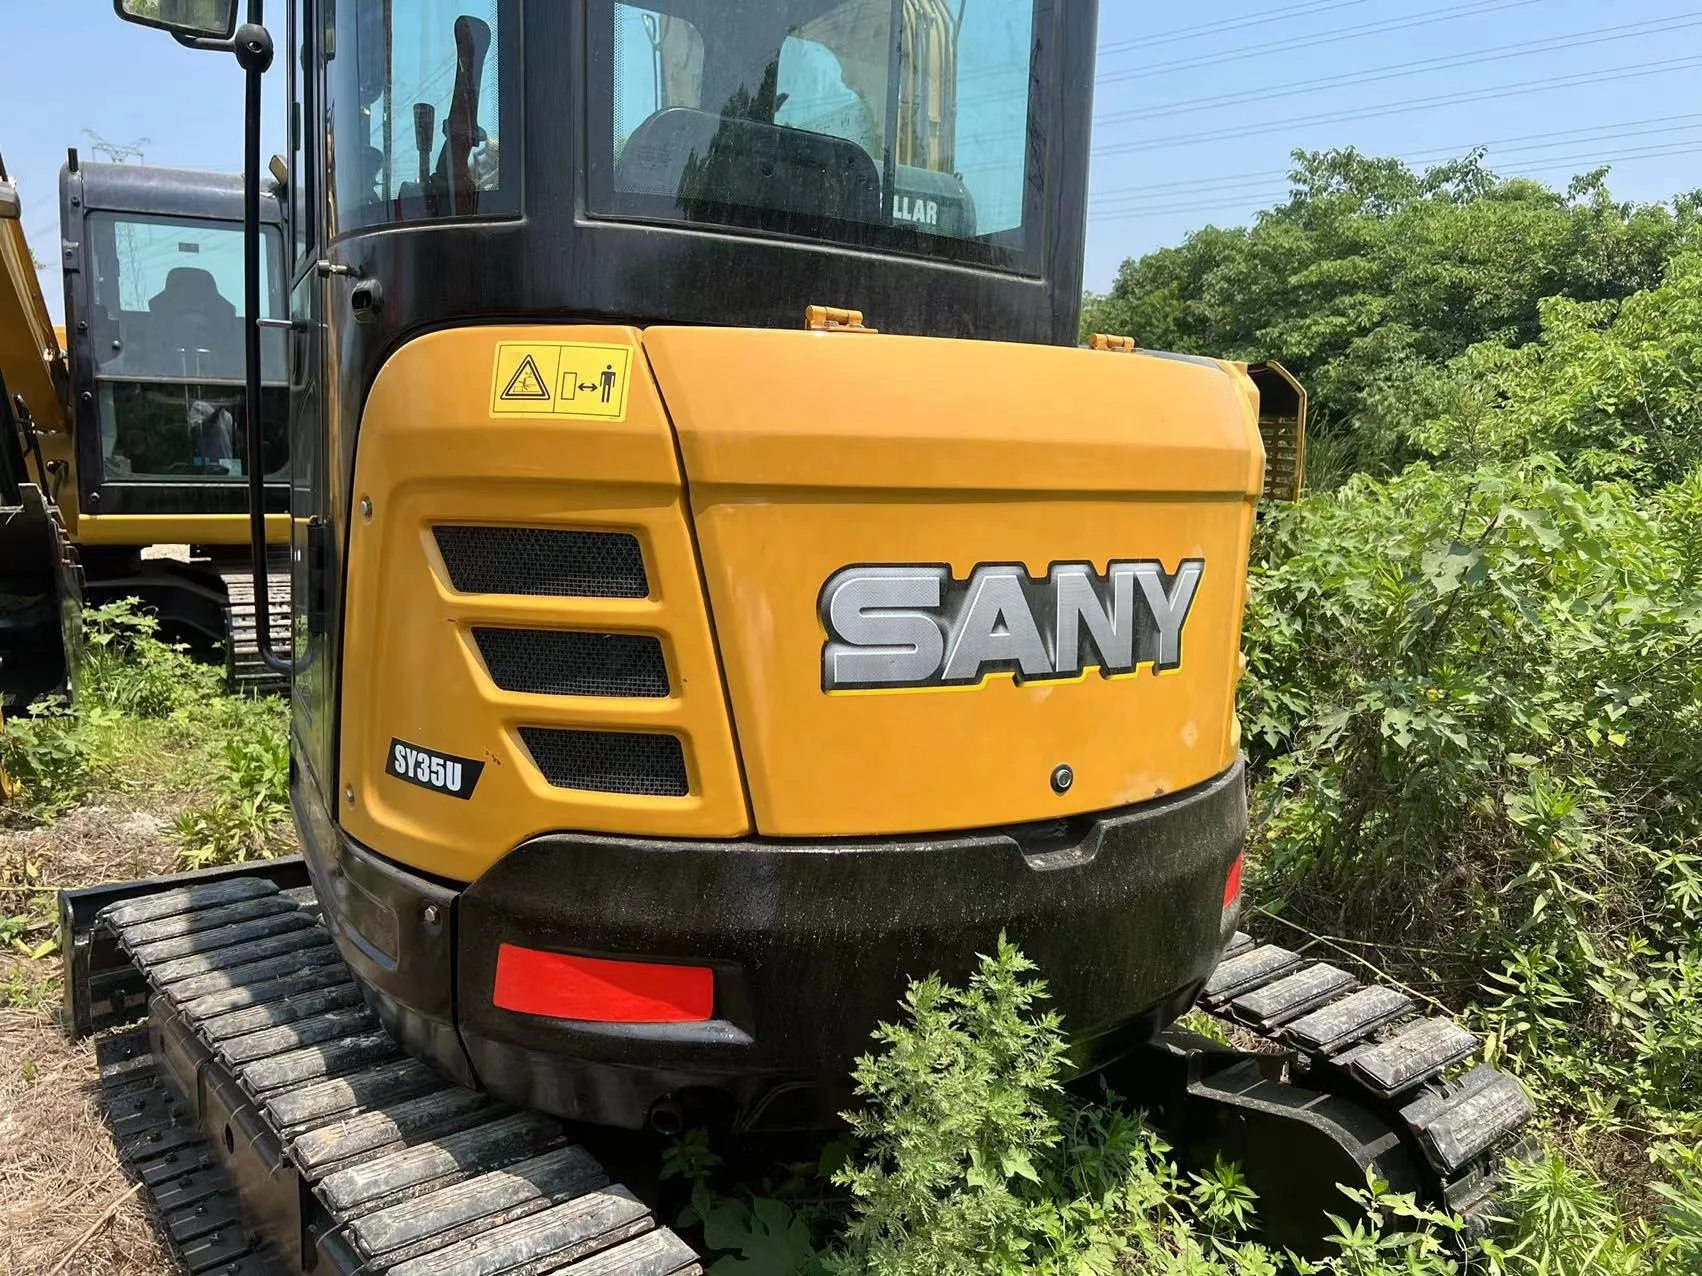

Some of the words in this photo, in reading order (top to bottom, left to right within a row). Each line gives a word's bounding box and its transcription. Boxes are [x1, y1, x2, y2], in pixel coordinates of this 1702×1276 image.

[880, 191, 937, 225] LLAR
[822, 562, 1203, 688] SANY
[394, 744, 462, 792] SY35U
